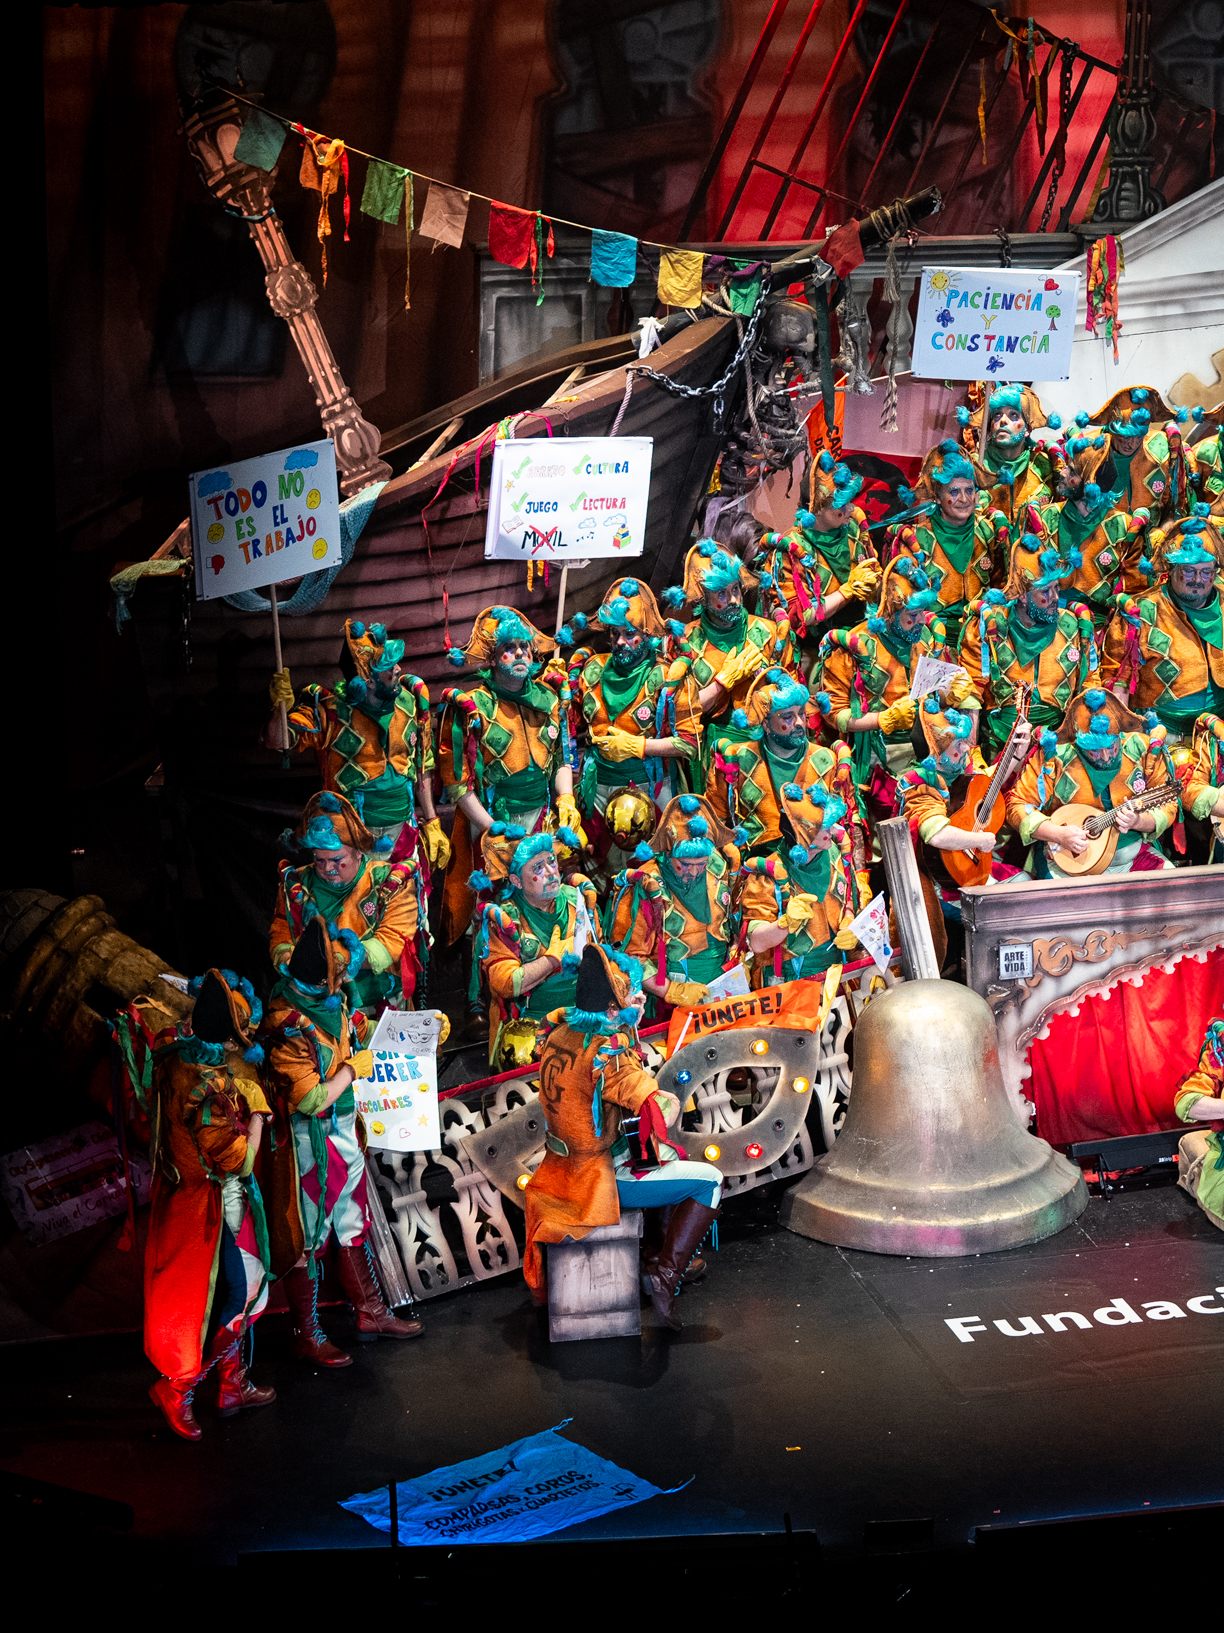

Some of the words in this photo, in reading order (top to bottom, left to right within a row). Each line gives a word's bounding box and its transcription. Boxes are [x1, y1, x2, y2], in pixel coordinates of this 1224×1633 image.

[981, 314, 997, 330] Y
[526, 465, 566, 478] ABRAZO
[585, 461, 629, 476] CULTURA
[207, 480, 268, 520] TODO
[278, 470, 304, 500] NO
[525, 501, 558, 514] JUEGO
[583, 497, 627, 511] LECTURA
[235, 516, 257, 541] ES
[272, 503, 289, 527] EL
[238, 514, 317, 564] TRABAJO
[1004, 950, 1025, 961] ARTE
[1004, 962, 1026, 972] VIDA
